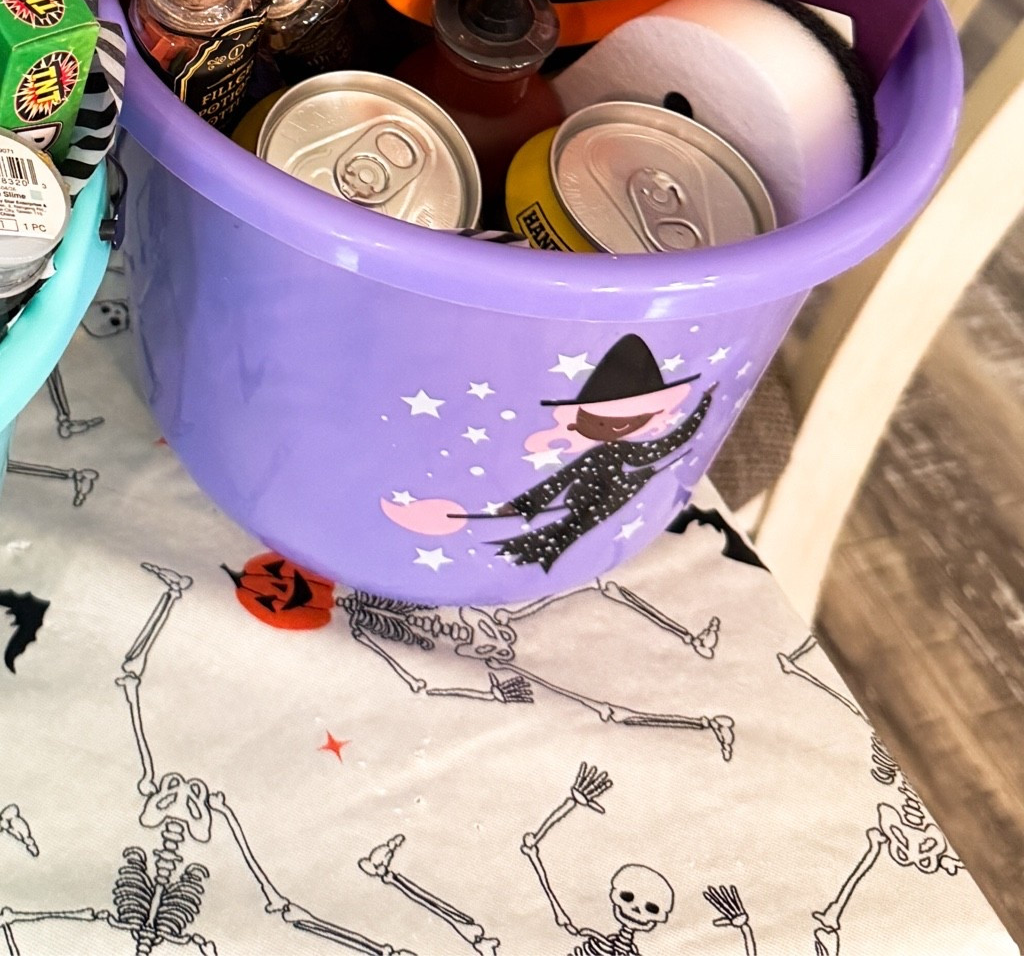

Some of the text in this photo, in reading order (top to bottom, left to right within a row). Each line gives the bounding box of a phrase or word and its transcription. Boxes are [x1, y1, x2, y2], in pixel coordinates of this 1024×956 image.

[31, 65, 62, 106] TNT
[197, 77, 248, 118] POTIO
[3, 190, 26, 199] Slime
[23, 222, 29, 231] 1
[32, 223, 47, 232] PC
